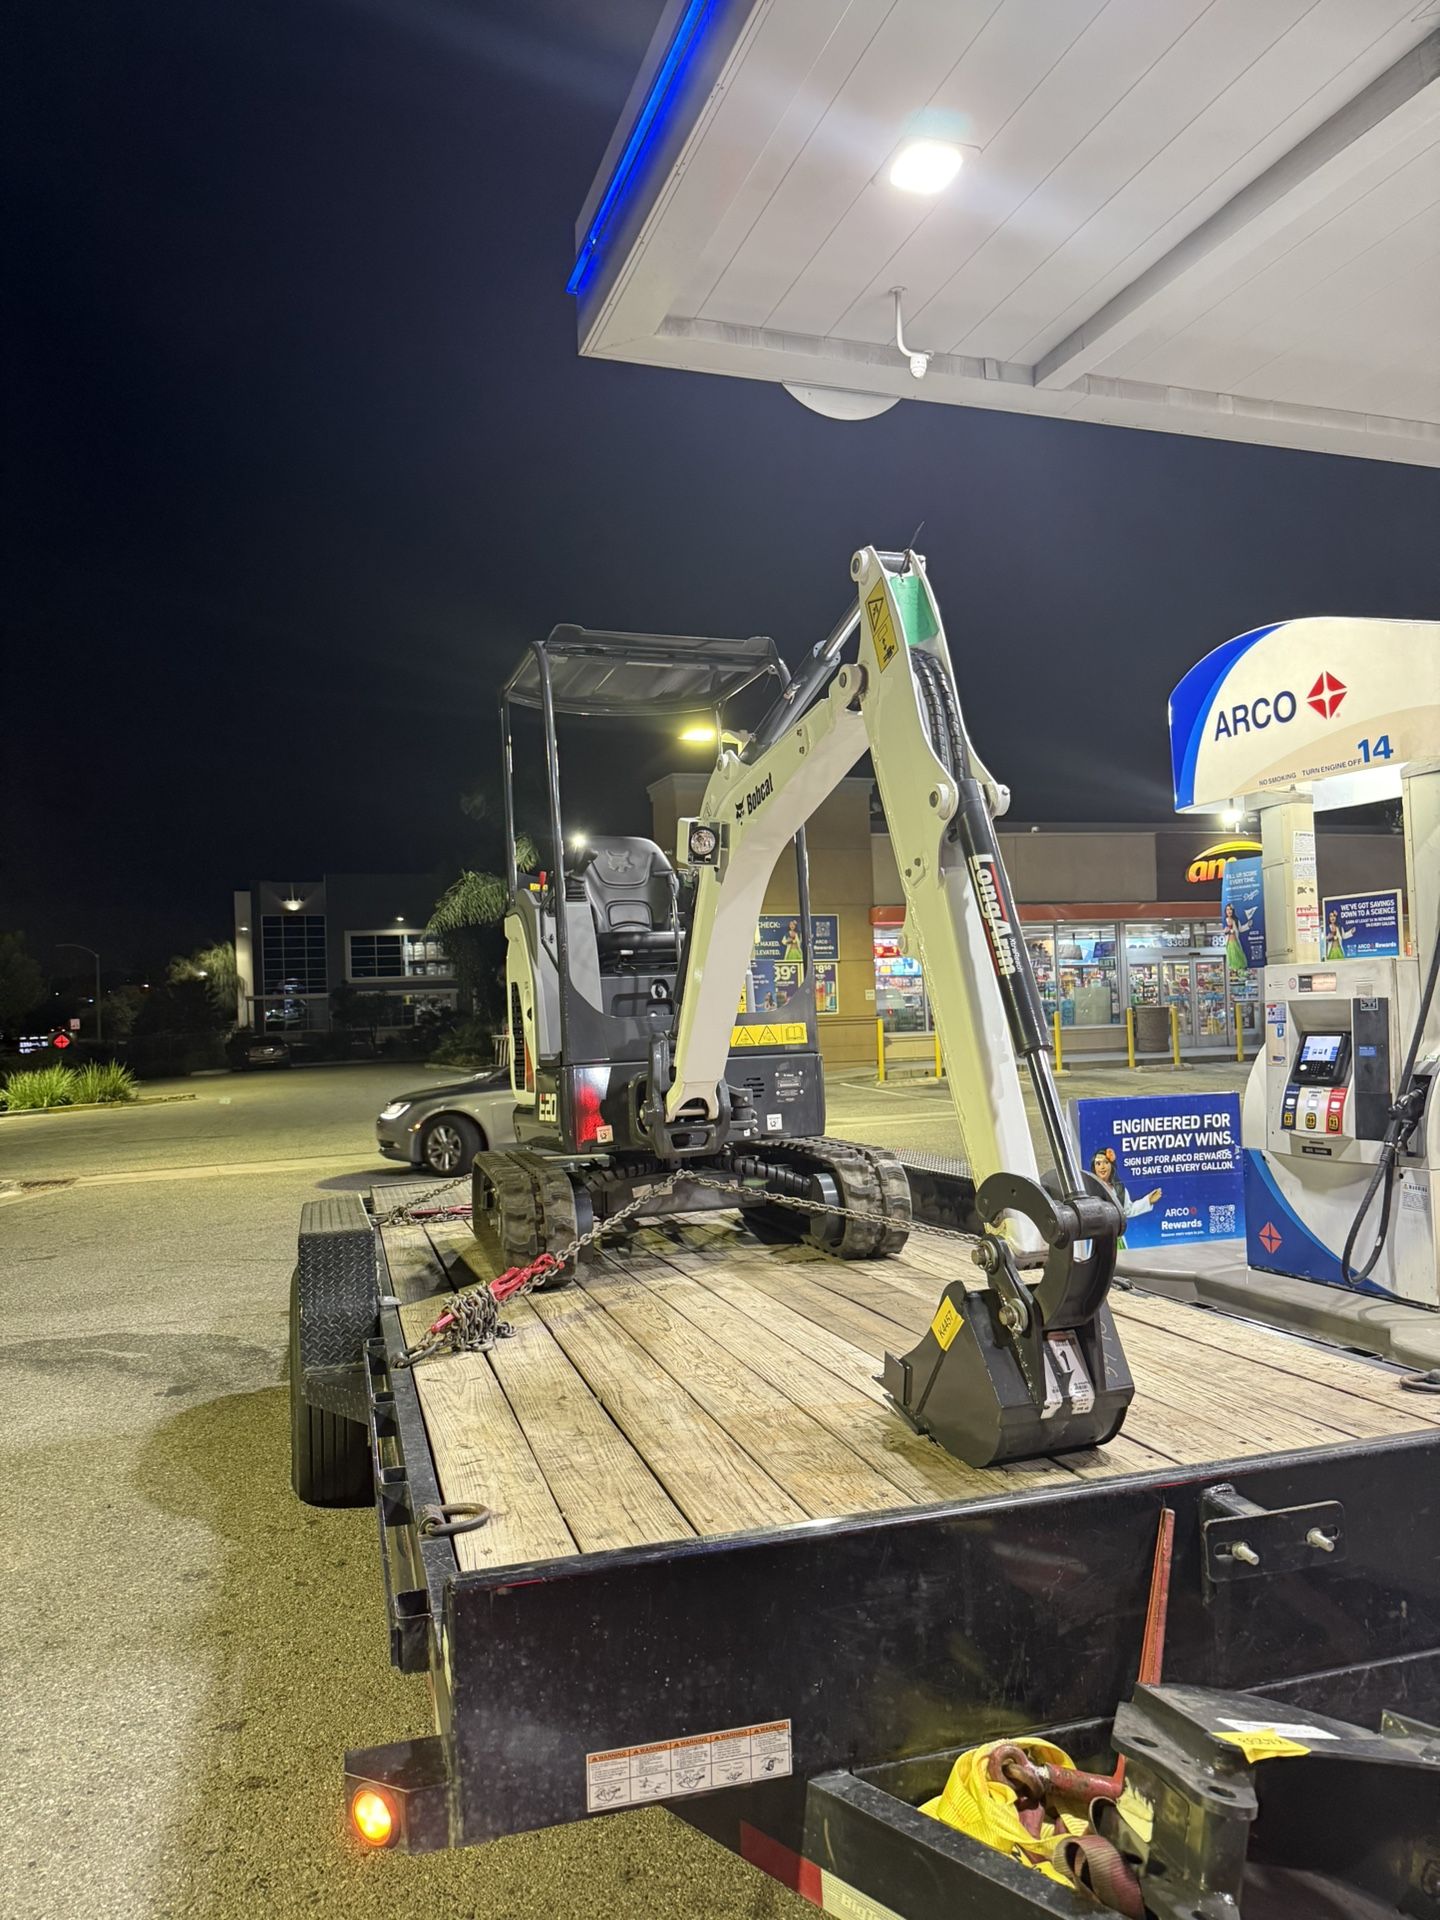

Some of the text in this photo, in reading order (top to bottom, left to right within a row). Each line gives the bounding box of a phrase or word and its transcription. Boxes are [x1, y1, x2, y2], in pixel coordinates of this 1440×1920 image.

[1214, 690, 1297, 742] ARCO
[1357, 735, 1394, 763] 14
[1302, 758, 1362, 776] TURN ENGINE OFF
[1268, 772, 1297, 785] SMOKING
[746, 772, 774, 816] Bobcat
[1340, 899, 1395, 911] WE'VE GOT SAVINGS
[969, 854, 1016, 976] LongArm
[1340, 910, 1358, 918] DOWN
[1113, 1113, 1230, 1135] ENGINEERED FOR
[1122, 1130, 1235, 1152] EVERYDAY WINS.
[1124, 1150, 1232, 1167] SIGN UP FOR ARCO REWARDS
[1130, 1161, 1235, 1176] TO SAVE ON EVERY GALLON.
[1164, 1207, 1190, 1218] ARCO
[1162, 1218, 1202, 1230] Rewards
[721, 1730, 748, 1738] WARNING
[760, 1724, 787, 1732] WARNING
[640, 1744, 668, 1753] WARNING
[680, 1738, 708, 1746] WARNING
[598, 1752, 627, 1760] WARNING
